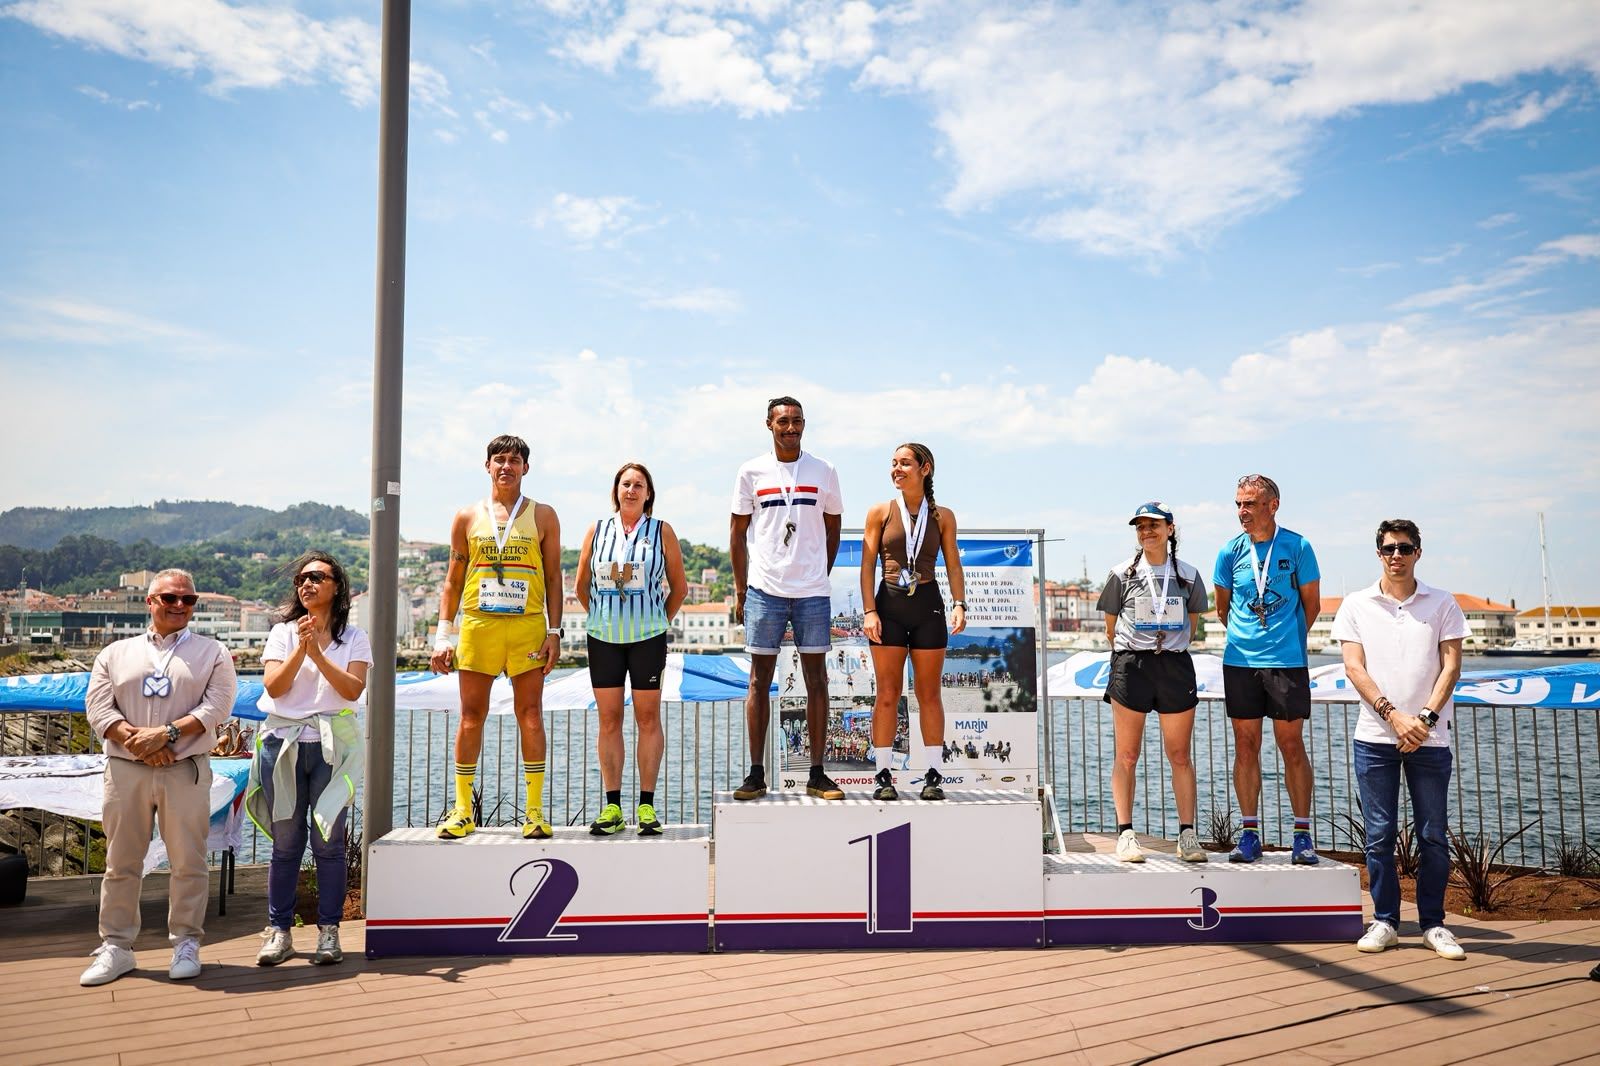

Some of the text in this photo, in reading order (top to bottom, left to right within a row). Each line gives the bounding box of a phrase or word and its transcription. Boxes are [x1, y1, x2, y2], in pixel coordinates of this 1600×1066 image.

[480, 545, 529, 556] ATHETICS
[498, 592, 526, 600] MANUEL
[511, 581, 525, 589] 432
[848, 821, 912, 933] 1
[498, 858, 579, 942] 2
[1187, 886, 1222, 930] 3
